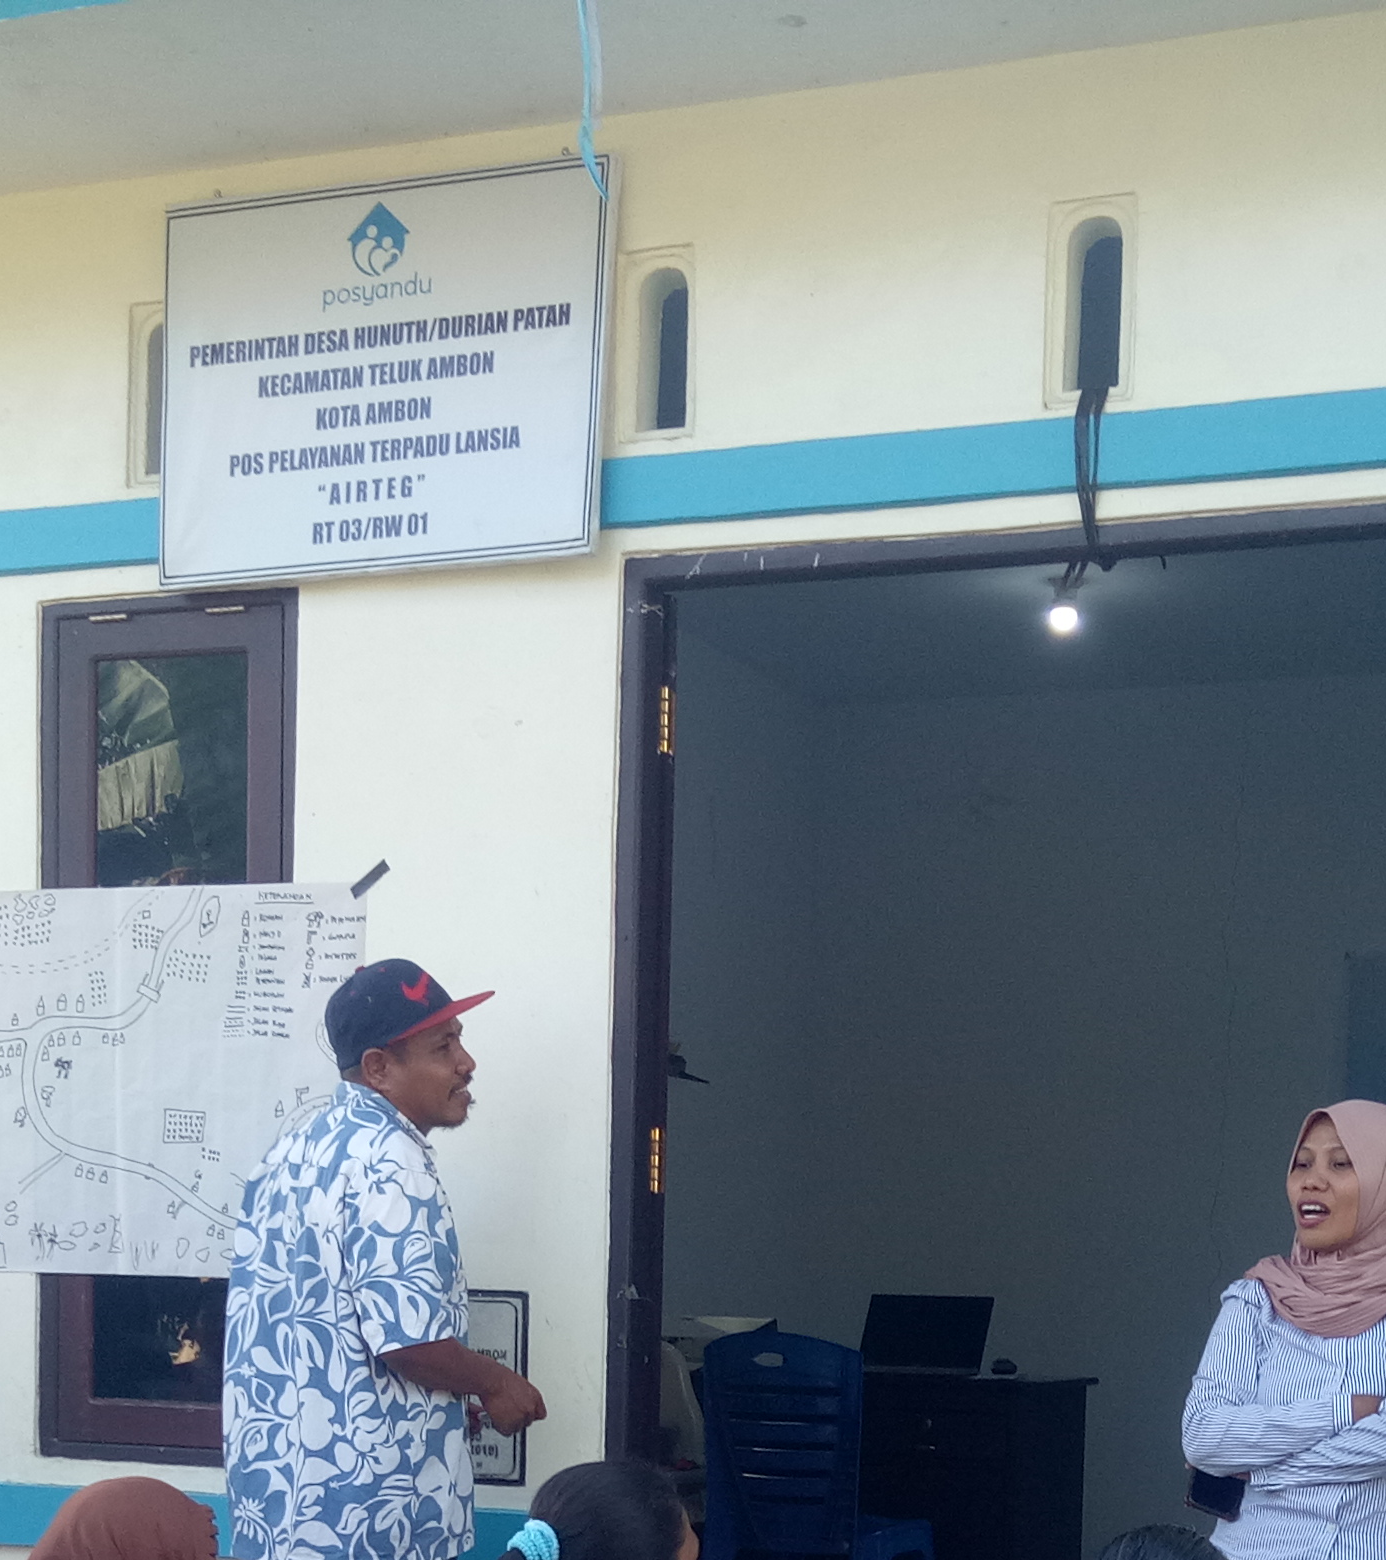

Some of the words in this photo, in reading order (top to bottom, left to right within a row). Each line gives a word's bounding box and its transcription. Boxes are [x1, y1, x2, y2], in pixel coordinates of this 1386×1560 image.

[322, 272, 432, 311] posyandu
[190, 335, 299, 367] PEMERINTAH
[304, 331, 349, 356] DESA
[513, 303, 571, 331] PATAH
[258, 366, 363, 398] KECAMATAN
[369, 359, 422, 387] TELUK
[427, 351, 494, 380] AMBON
[316, 405, 360, 430] KOTA
[366, 397, 431, 425] AMBON
[229, 453, 263, 477] POS
[269, 442, 365, 473] PELAYANAN
[370, 433, 450, 464] TERPADU
[456, 426, 520, 454] LANSIA
[312, 521, 335, 545] RT
[407, 512, 429, 536] 01
